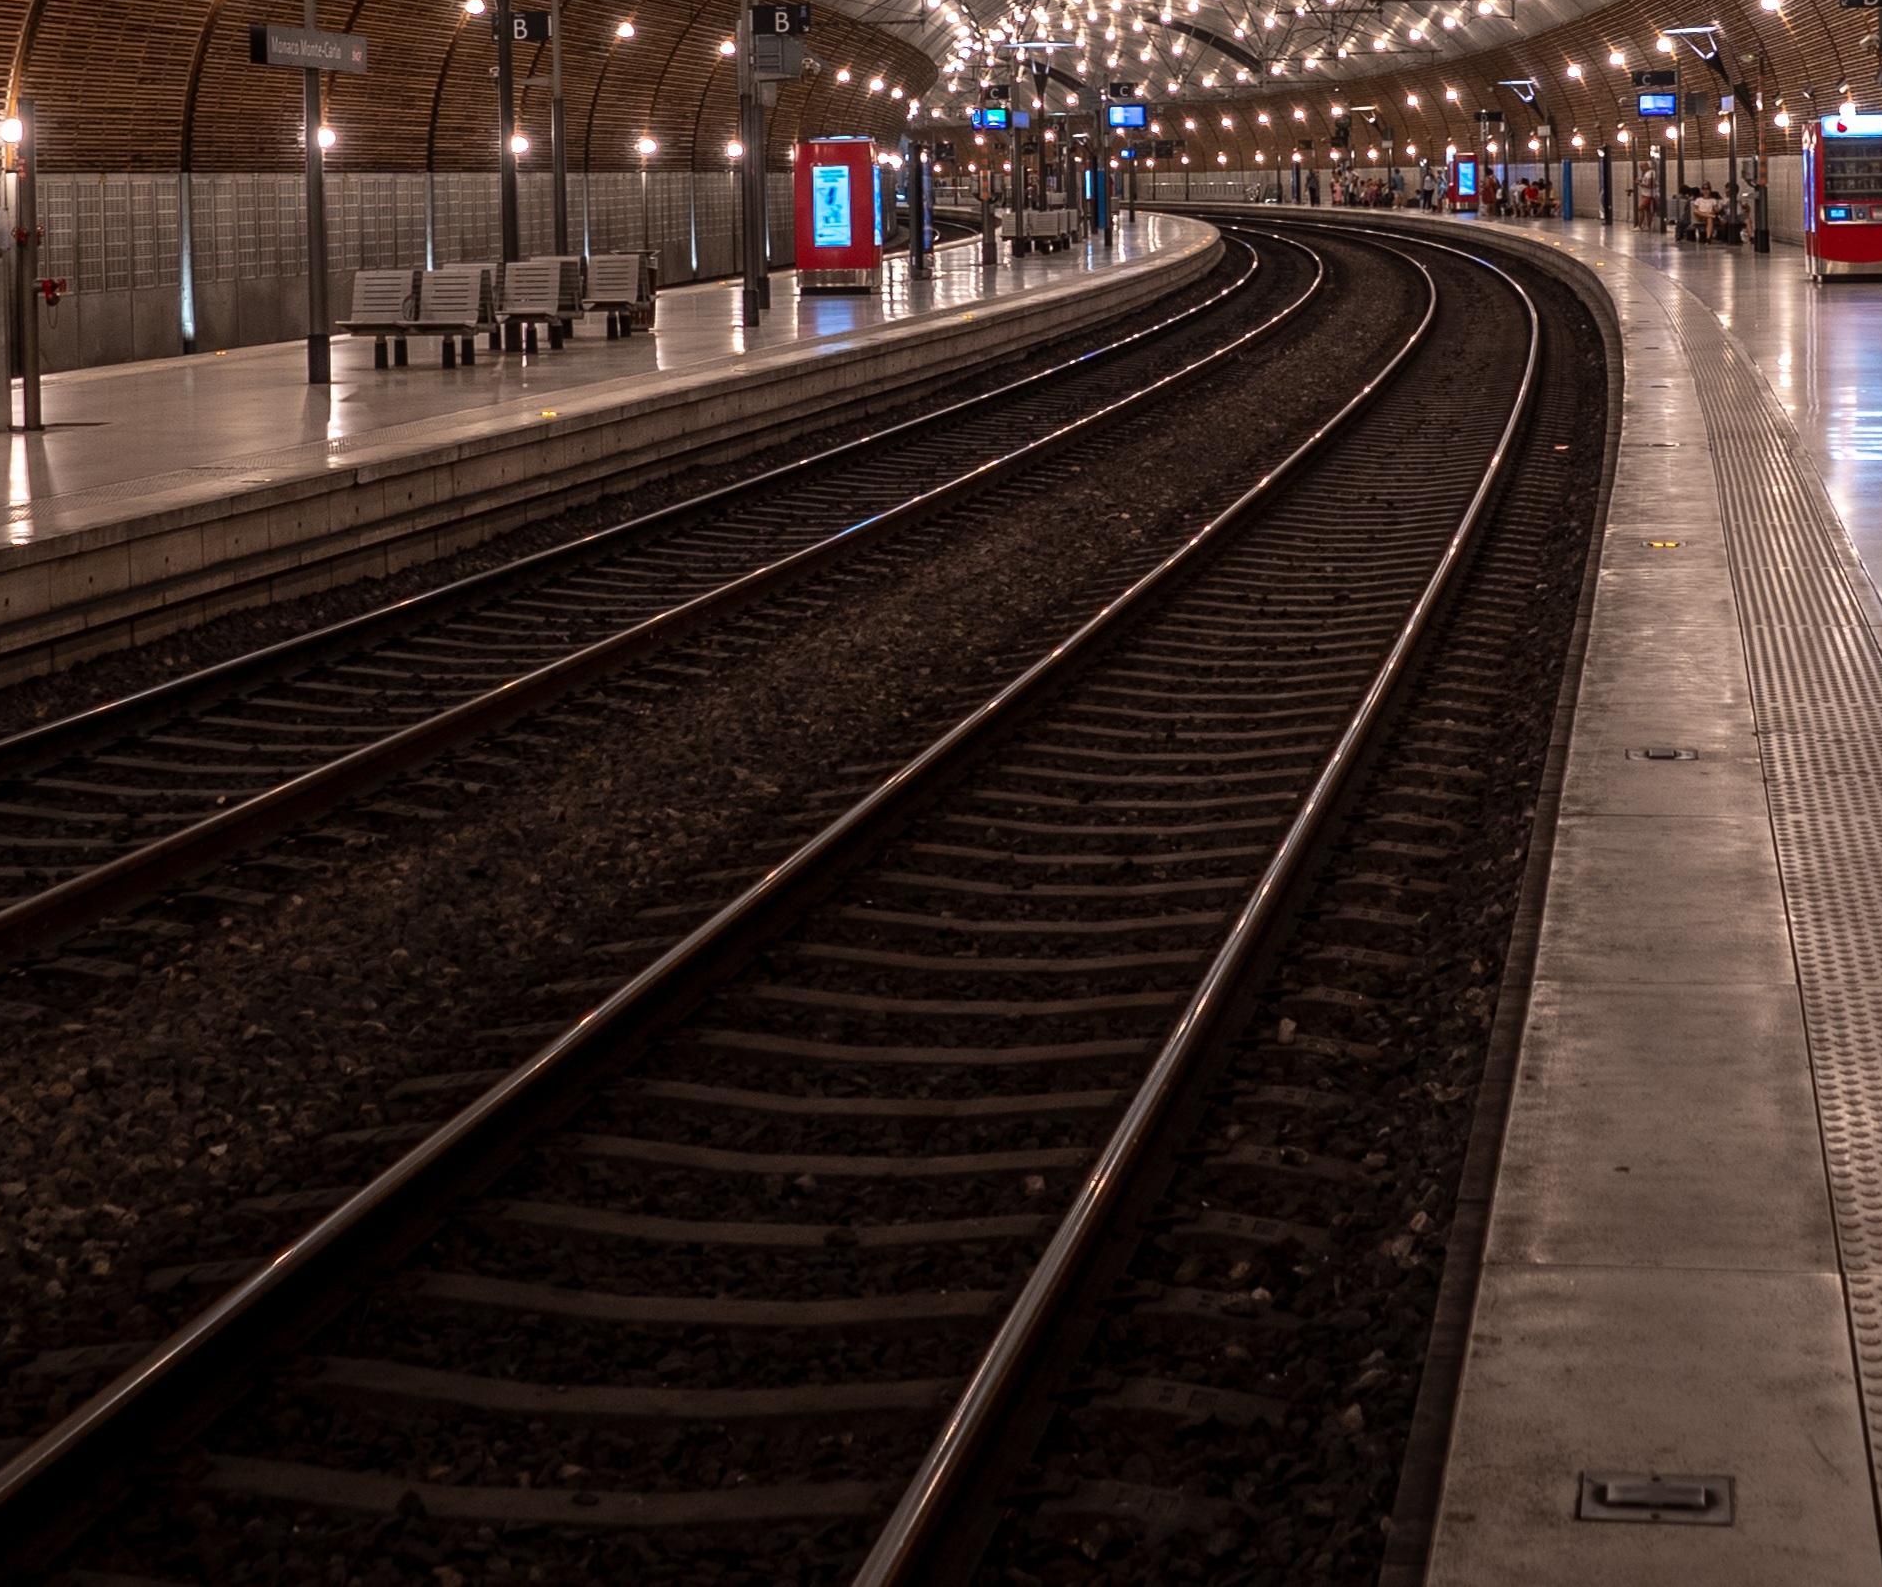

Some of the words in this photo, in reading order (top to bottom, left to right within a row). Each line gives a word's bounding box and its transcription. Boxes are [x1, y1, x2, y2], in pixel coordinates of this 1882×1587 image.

[513, 18, 528, 40] B
[774, 11, 790, 33] B
[270, 35, 299, 56] Monaco
[300, 38, 342, 60] Monte-Carlo
[1642, 74, 1652, 86] C
[990, 88, 1000, 100] C
[1119, 85, 1129, 98] C
